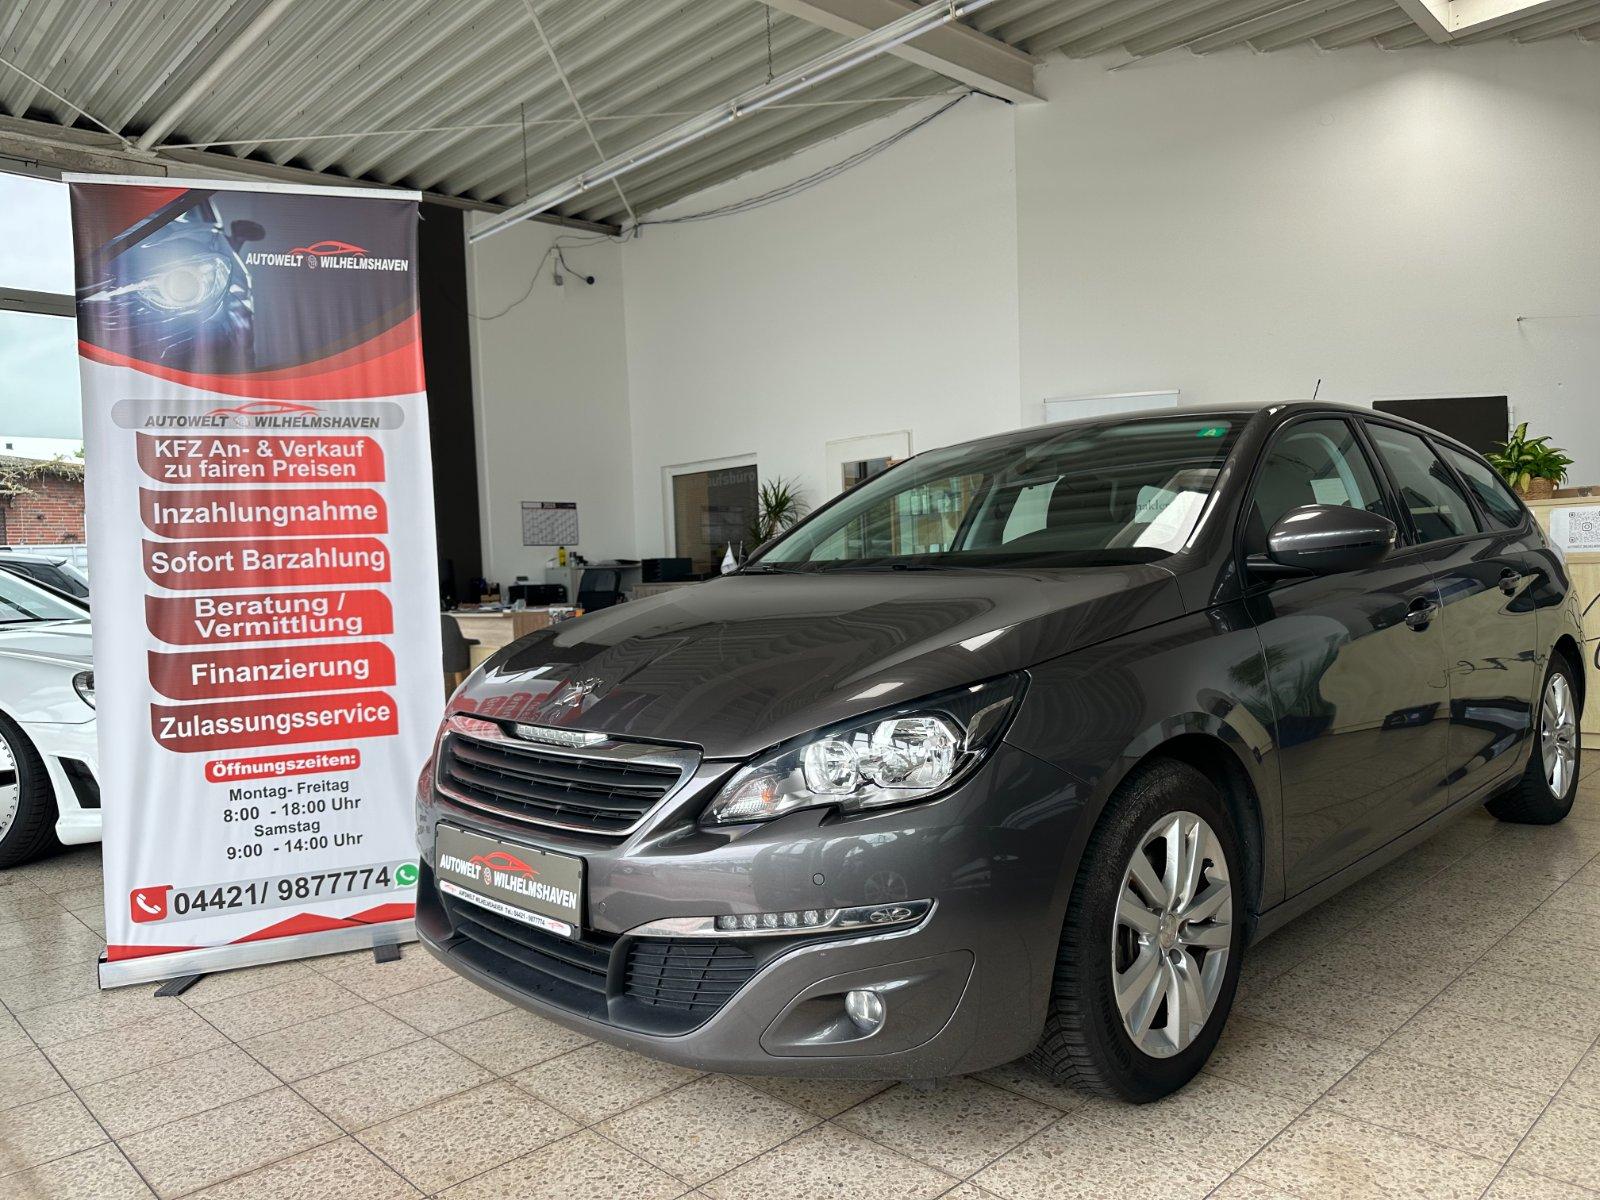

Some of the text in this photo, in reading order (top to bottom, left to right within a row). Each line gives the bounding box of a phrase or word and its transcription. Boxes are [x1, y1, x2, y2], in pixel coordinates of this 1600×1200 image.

[246, 253, 409, 272] AUTOWELT WILHELMSHAVEN
[145, 415, 380, 429] AUTOWELT WILHELMSHAVEN
[154, 439, 364, 458] KFZ An- & Verkauf
[164, 459, 356, 478] zu fairen Preisen
[153, 500, 378, 527] Inzahlungnahme
[151, 547, 386, 574] Sofort Barzahlung
[194, 592, 346, 618] Beratung /
[194, 614, 363, 639] Vermittlung
[191, 657, 370, 686] Finanzierung
[159, 702, 391, 741] Zulassungsservice
[212, 753, 357, 778] Öffnungszeiten:
[297, 778, 350, 796] Freitag
[223, 806, 260, 823] 8:00
[282, 799, 327, 817] 18:00
[331, 796, 362, 812] Uhr
[254, 820, 321, 838] Samstag
[226, 843, 263, 861] 9:00
[284, 836, 328, 854] 14:00
[333, 832, 363, 848] Uhr
[174, 866, 391, 915] 04421/ 9877774
[439, 853, 578, 910] AUTOWELT WILHELMSHAVEN
